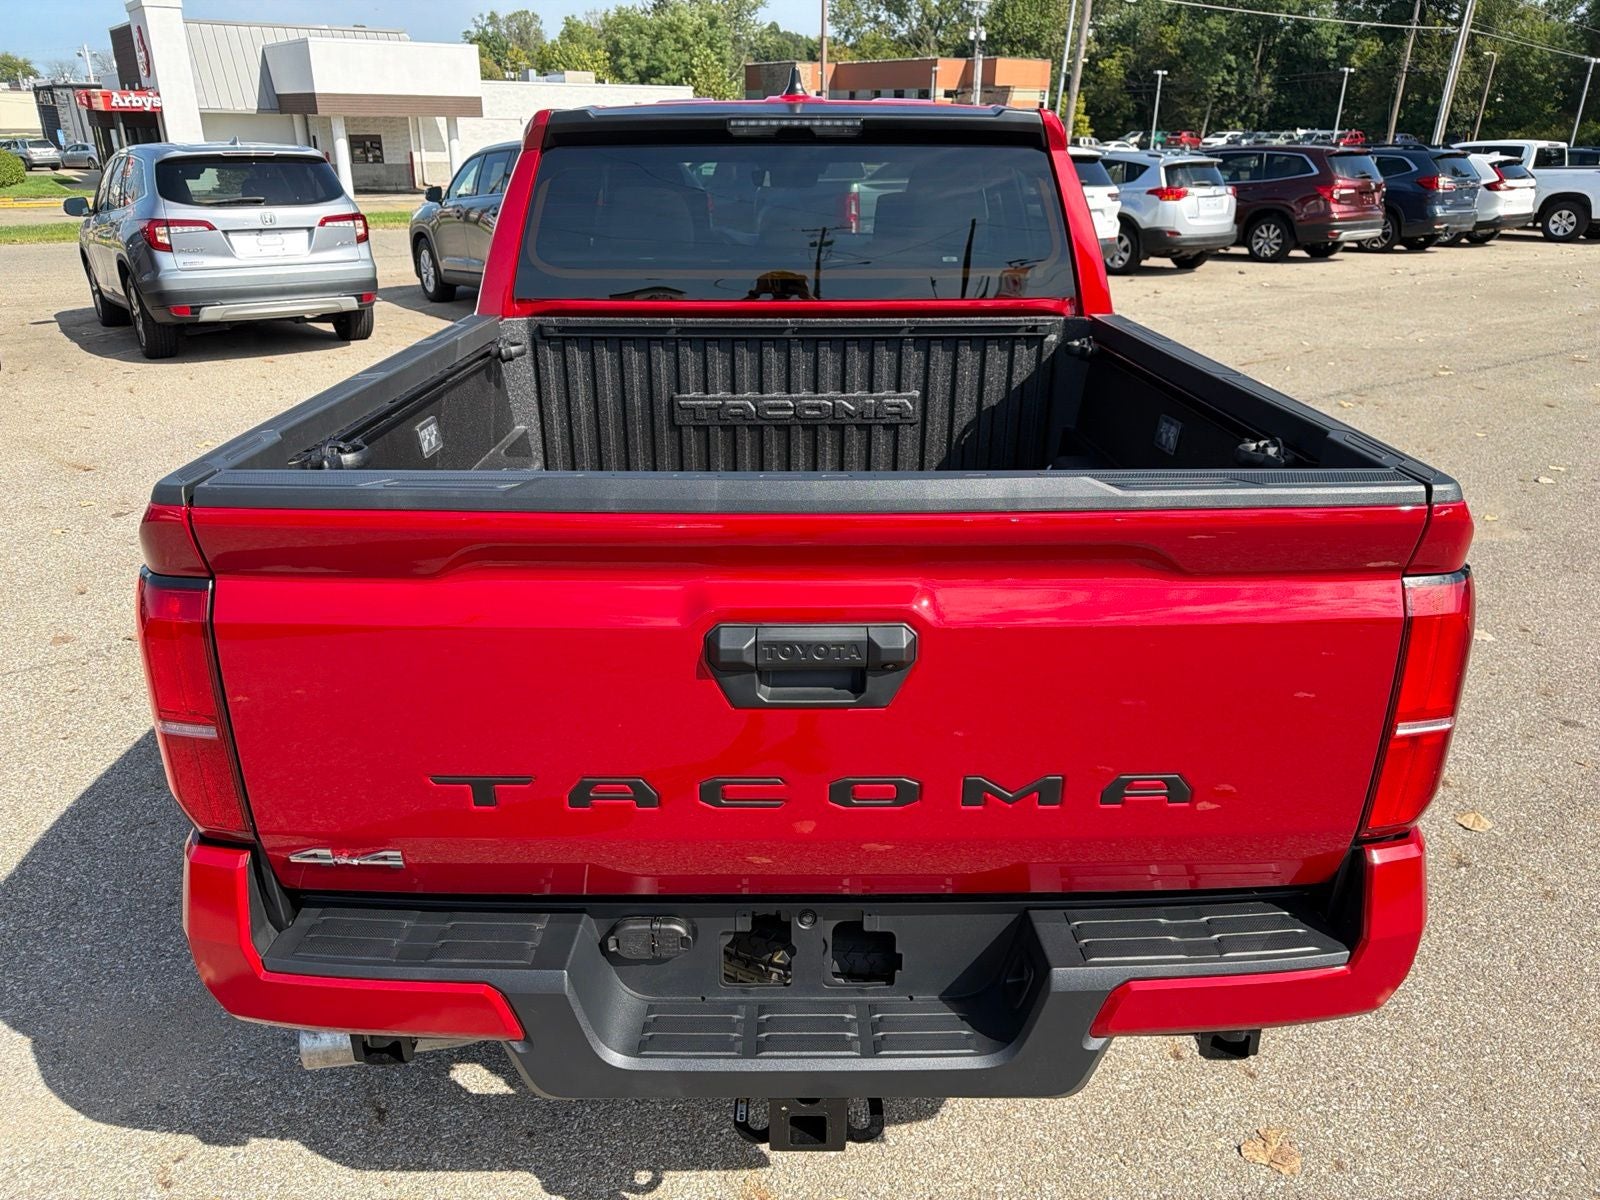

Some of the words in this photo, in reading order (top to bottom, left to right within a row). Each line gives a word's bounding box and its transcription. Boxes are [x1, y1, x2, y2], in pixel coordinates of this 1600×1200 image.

[111, 91, 161, 111] Arby's
[678, 399, 913, 421] TACOMA
[762, 643, 862, 661] TOYOTA
[429, 774, 1194, 810] TACOMA
